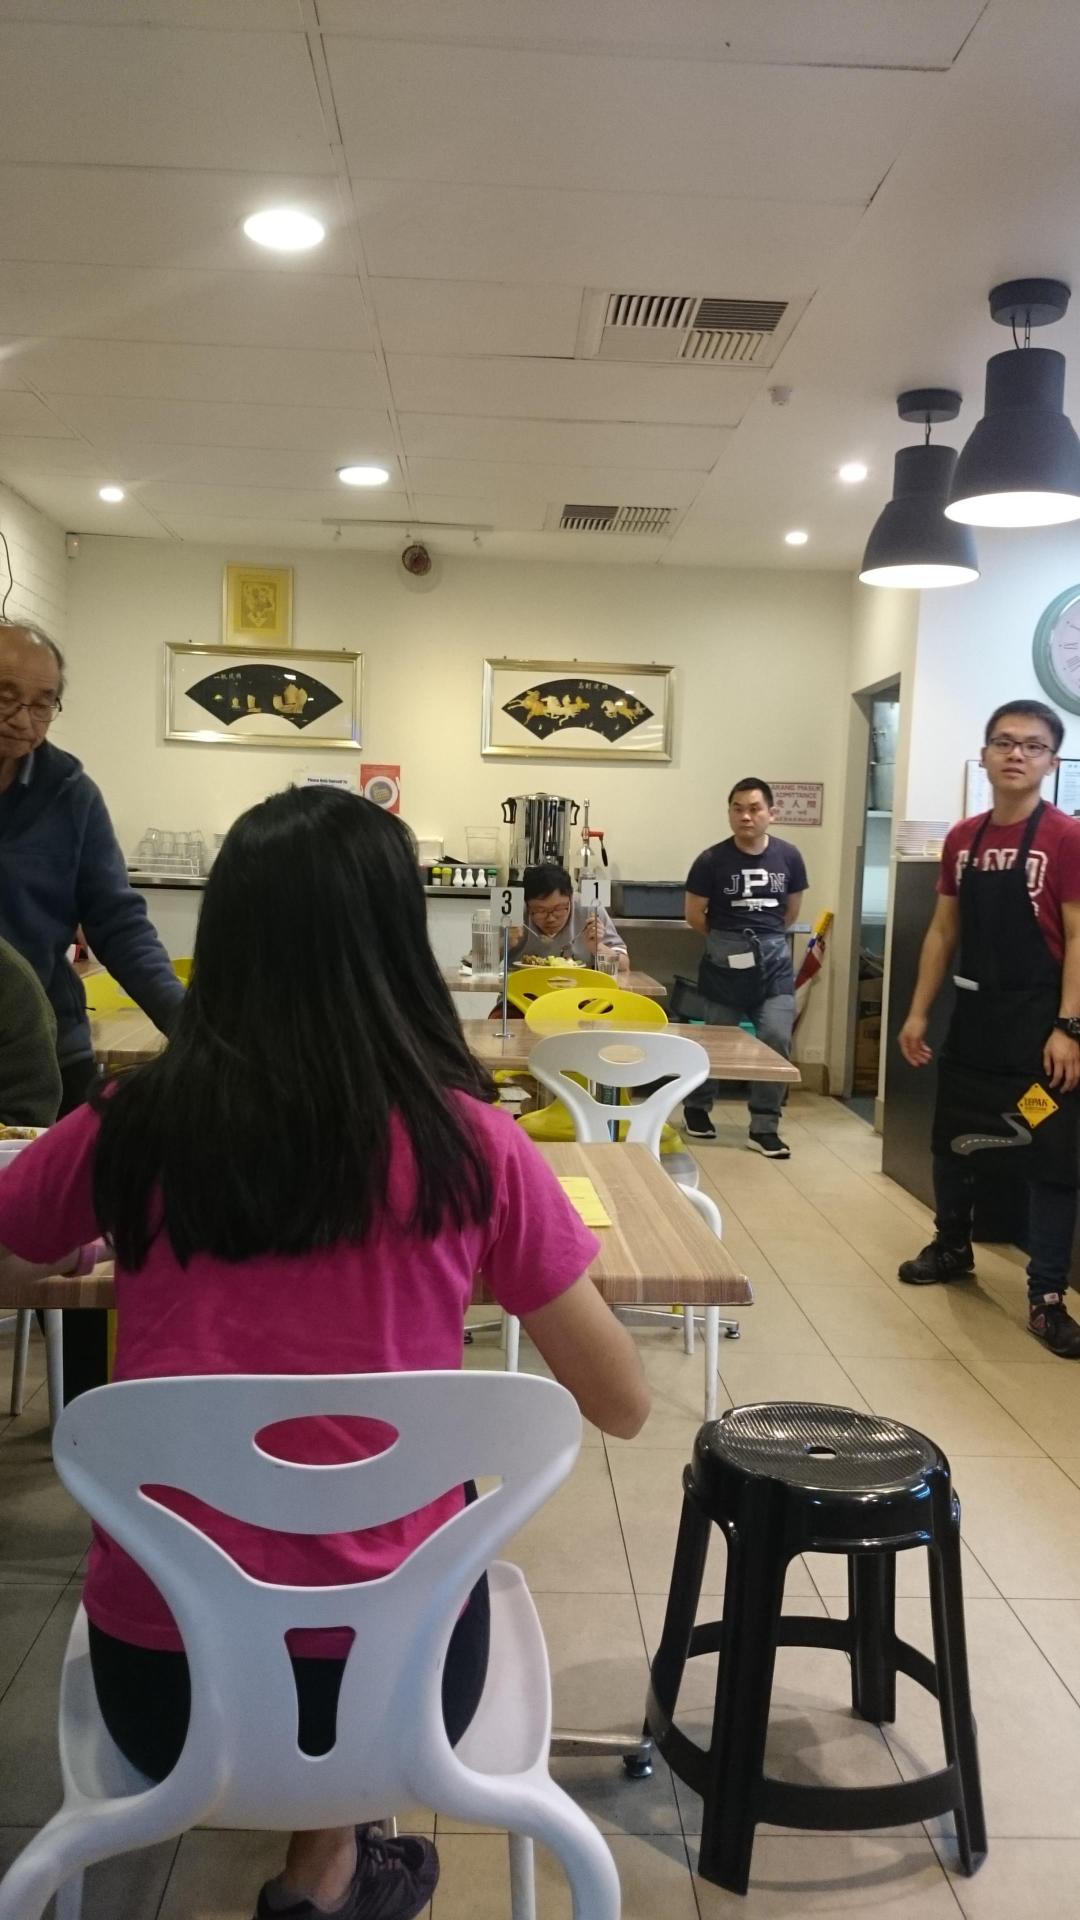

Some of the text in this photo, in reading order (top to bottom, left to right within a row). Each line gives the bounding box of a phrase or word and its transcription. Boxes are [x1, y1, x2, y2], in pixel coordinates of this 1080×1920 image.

[593, 882, 599, 899] 1
[723, 868, 785, 897] JPN
[501, 890, 512, 915] 3
